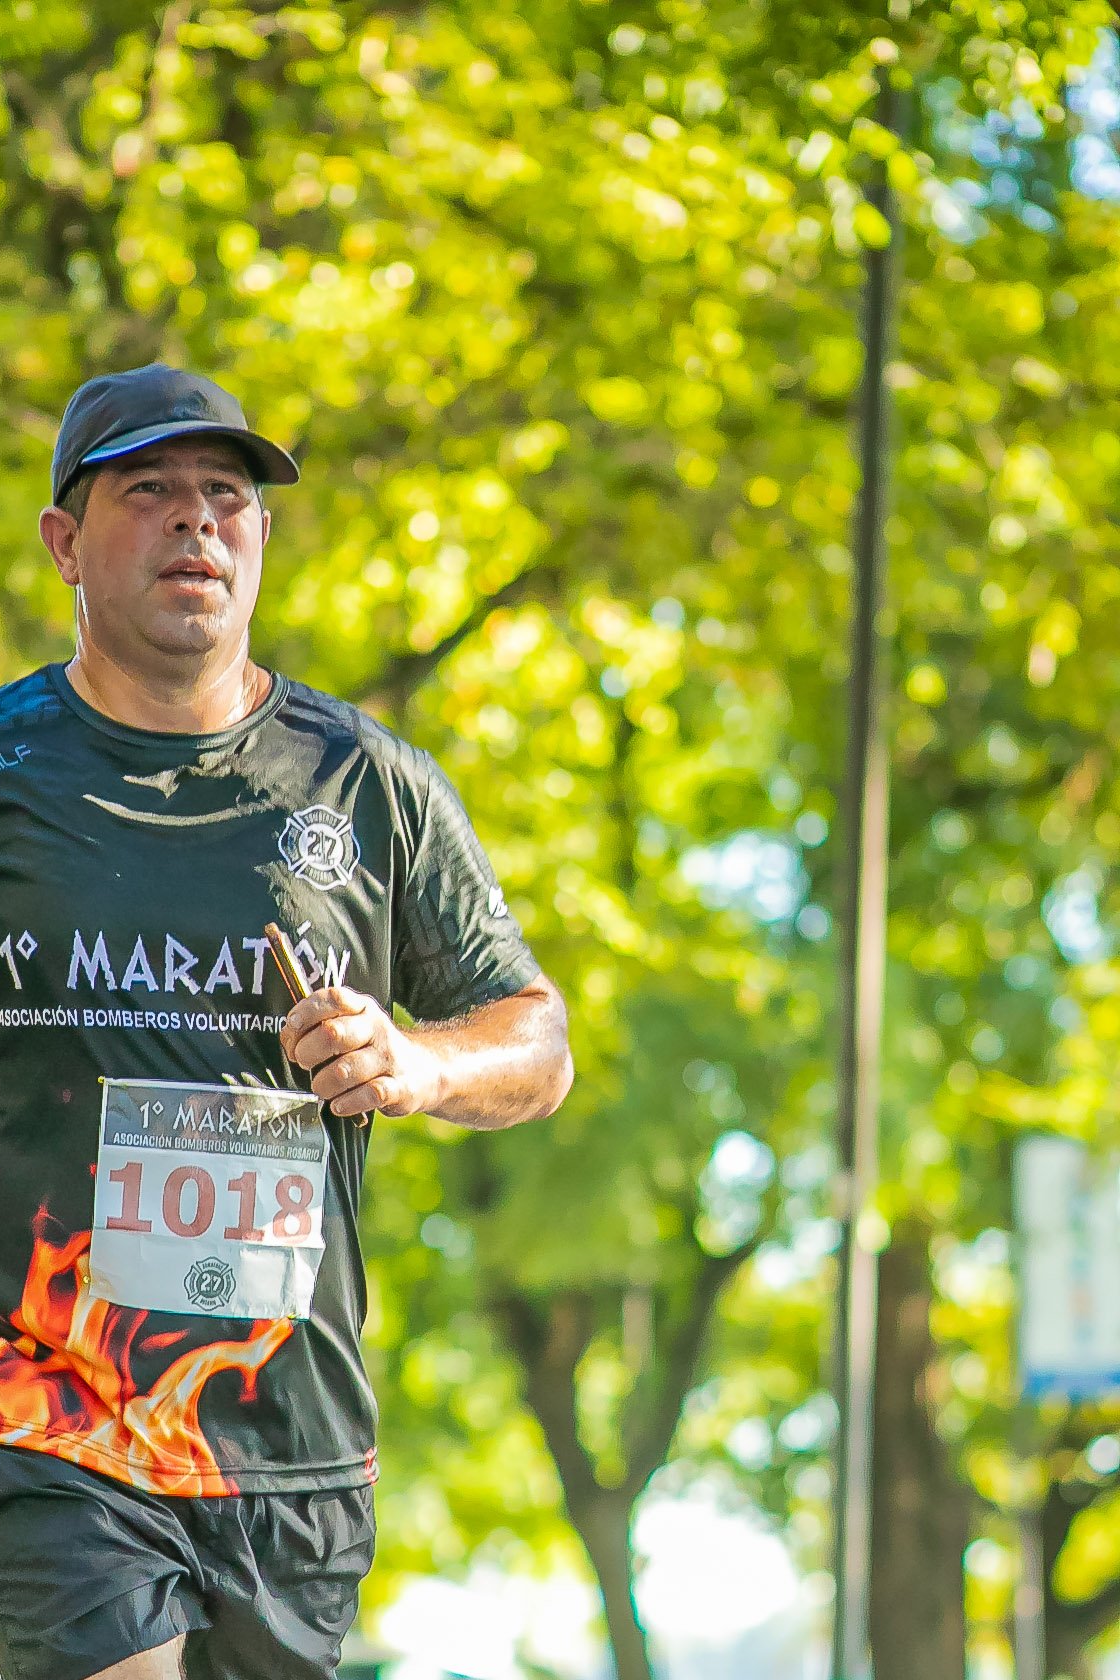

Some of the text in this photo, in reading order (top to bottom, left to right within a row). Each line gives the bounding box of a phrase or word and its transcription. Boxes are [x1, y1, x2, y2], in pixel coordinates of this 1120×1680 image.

[307, 830, 337, 858] 27
[83, 1008, 181, 1031] BOMBEROS
[174, 1136, 227, 1154] BOMBEROS
[229, 1141, 285, 1158] VOLUNTARIOS
[286, 1146, 320, 1161] ROSARIO
[105, 1161, 314, 1244] 1018
[200, 1272, 222, 1292] 27
